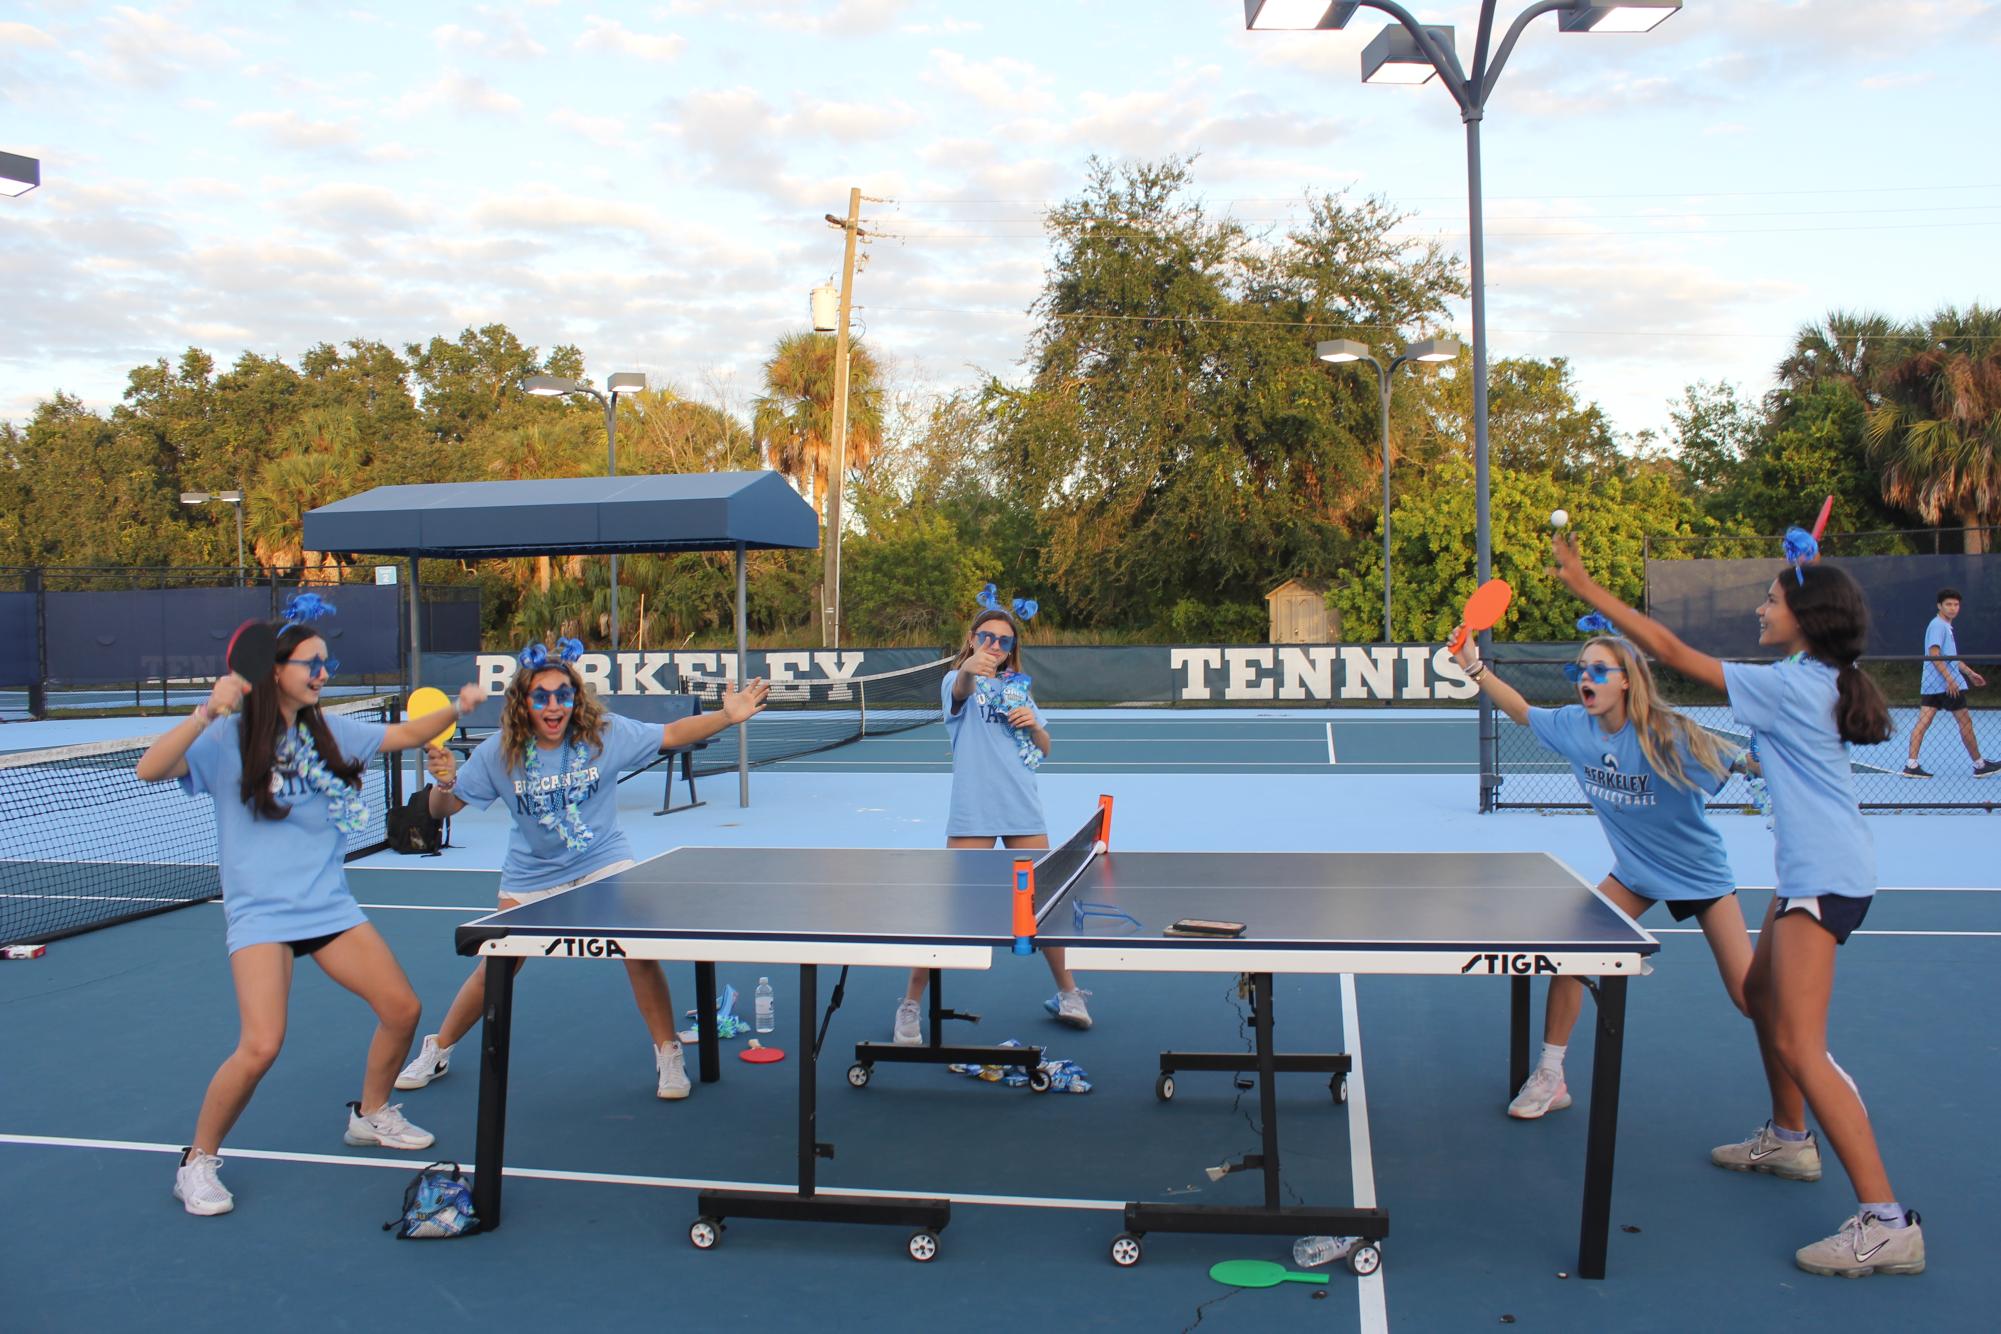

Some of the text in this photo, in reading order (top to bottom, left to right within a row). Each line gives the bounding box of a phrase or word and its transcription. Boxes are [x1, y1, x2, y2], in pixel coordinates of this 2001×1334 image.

[475, 647, 1480, 700] BRKEEY TENNIS
[1584, 766, 1649, 793] BERKELEY
[545, 938, 626, 957] STIGA
[1461, 953, 1558, 975] STIGA
